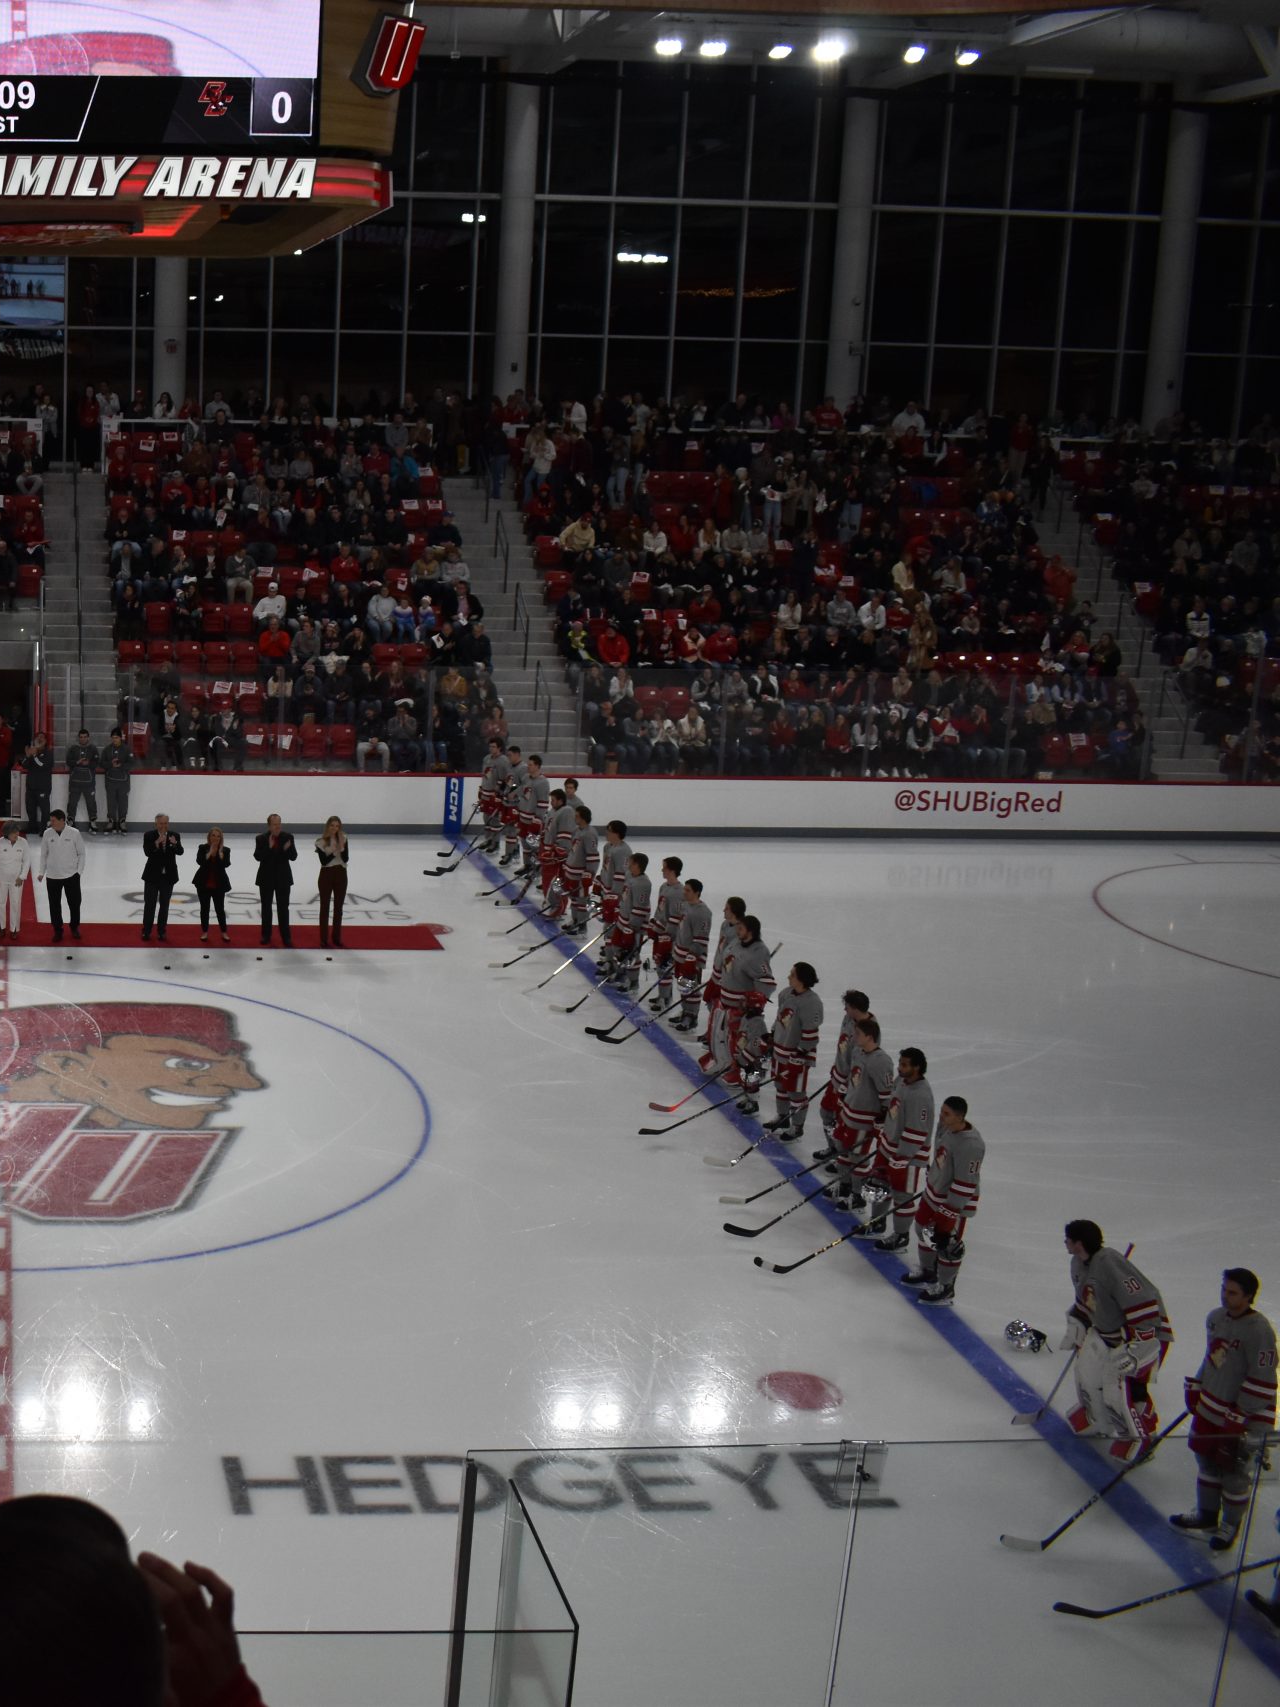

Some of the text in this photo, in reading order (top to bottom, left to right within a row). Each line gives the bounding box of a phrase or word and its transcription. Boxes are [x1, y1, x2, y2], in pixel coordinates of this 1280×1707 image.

[271, 91, 292, 124] 0
[143, 156, 317, 199] ARENA
[448, 777, 459, 822] CCM
[895, 790, 1062, 818] @SHUBigRed
[1123, 1277, 1141, 1295] 30
[1229, 1339, 1240, 1350] A
[1258, 1350, 1275, 1368] 27
[220, 1455, 900, 1515] HEDGEYE
